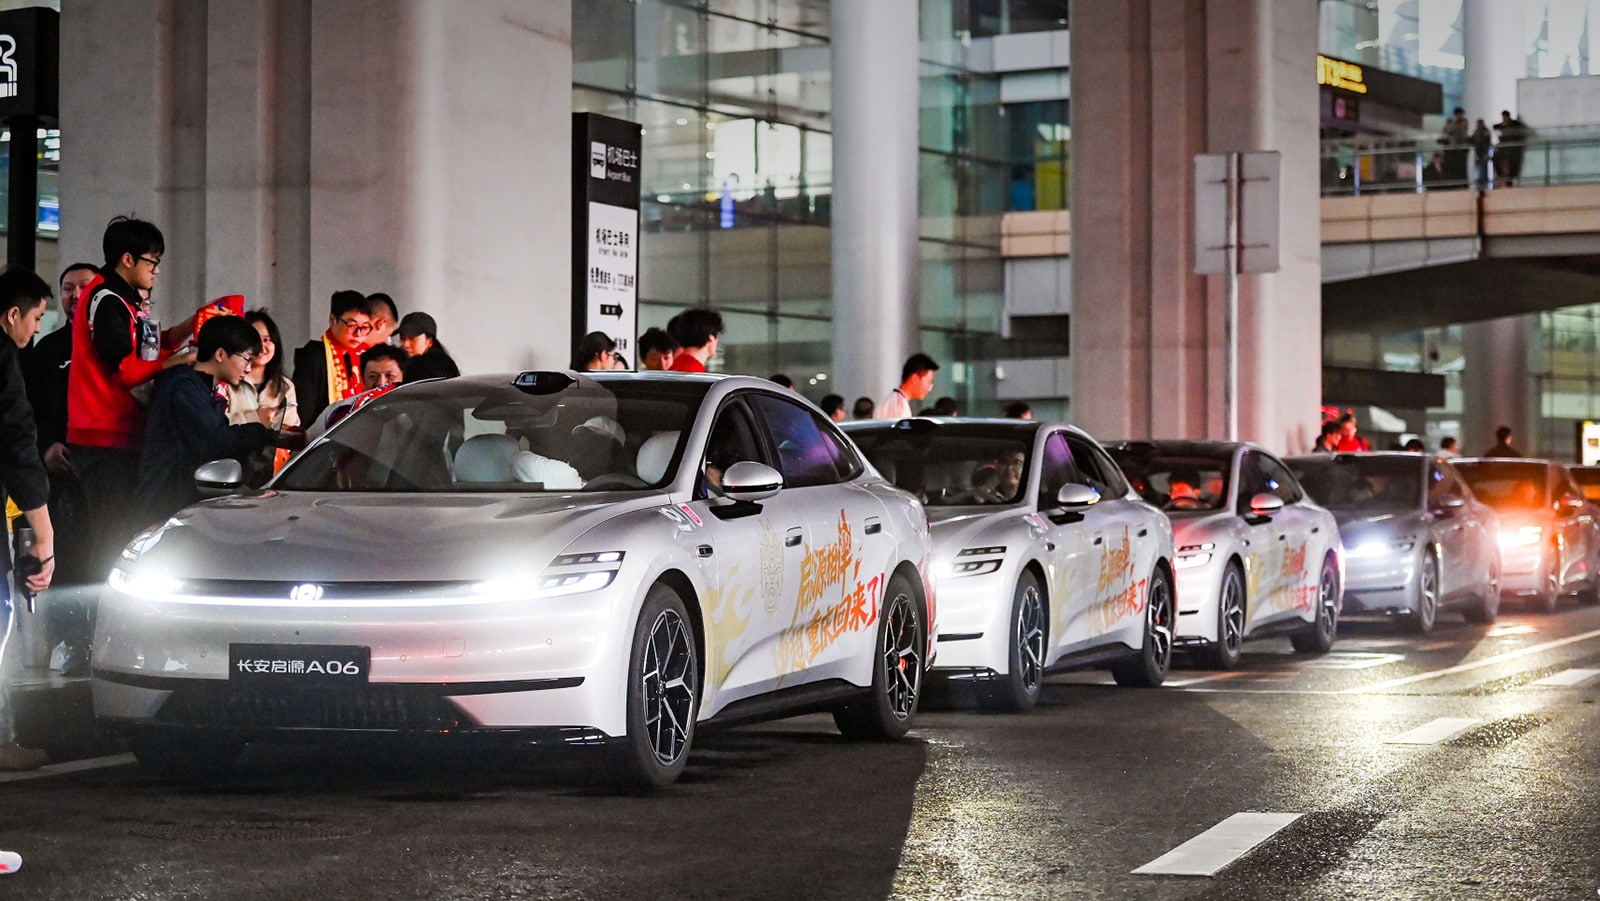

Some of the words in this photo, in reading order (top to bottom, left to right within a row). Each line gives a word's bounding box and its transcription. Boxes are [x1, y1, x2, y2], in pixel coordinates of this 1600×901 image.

[607, 146, 638, 168] 机场巴士
[237, 659, 360, 675] 长安启源A06
